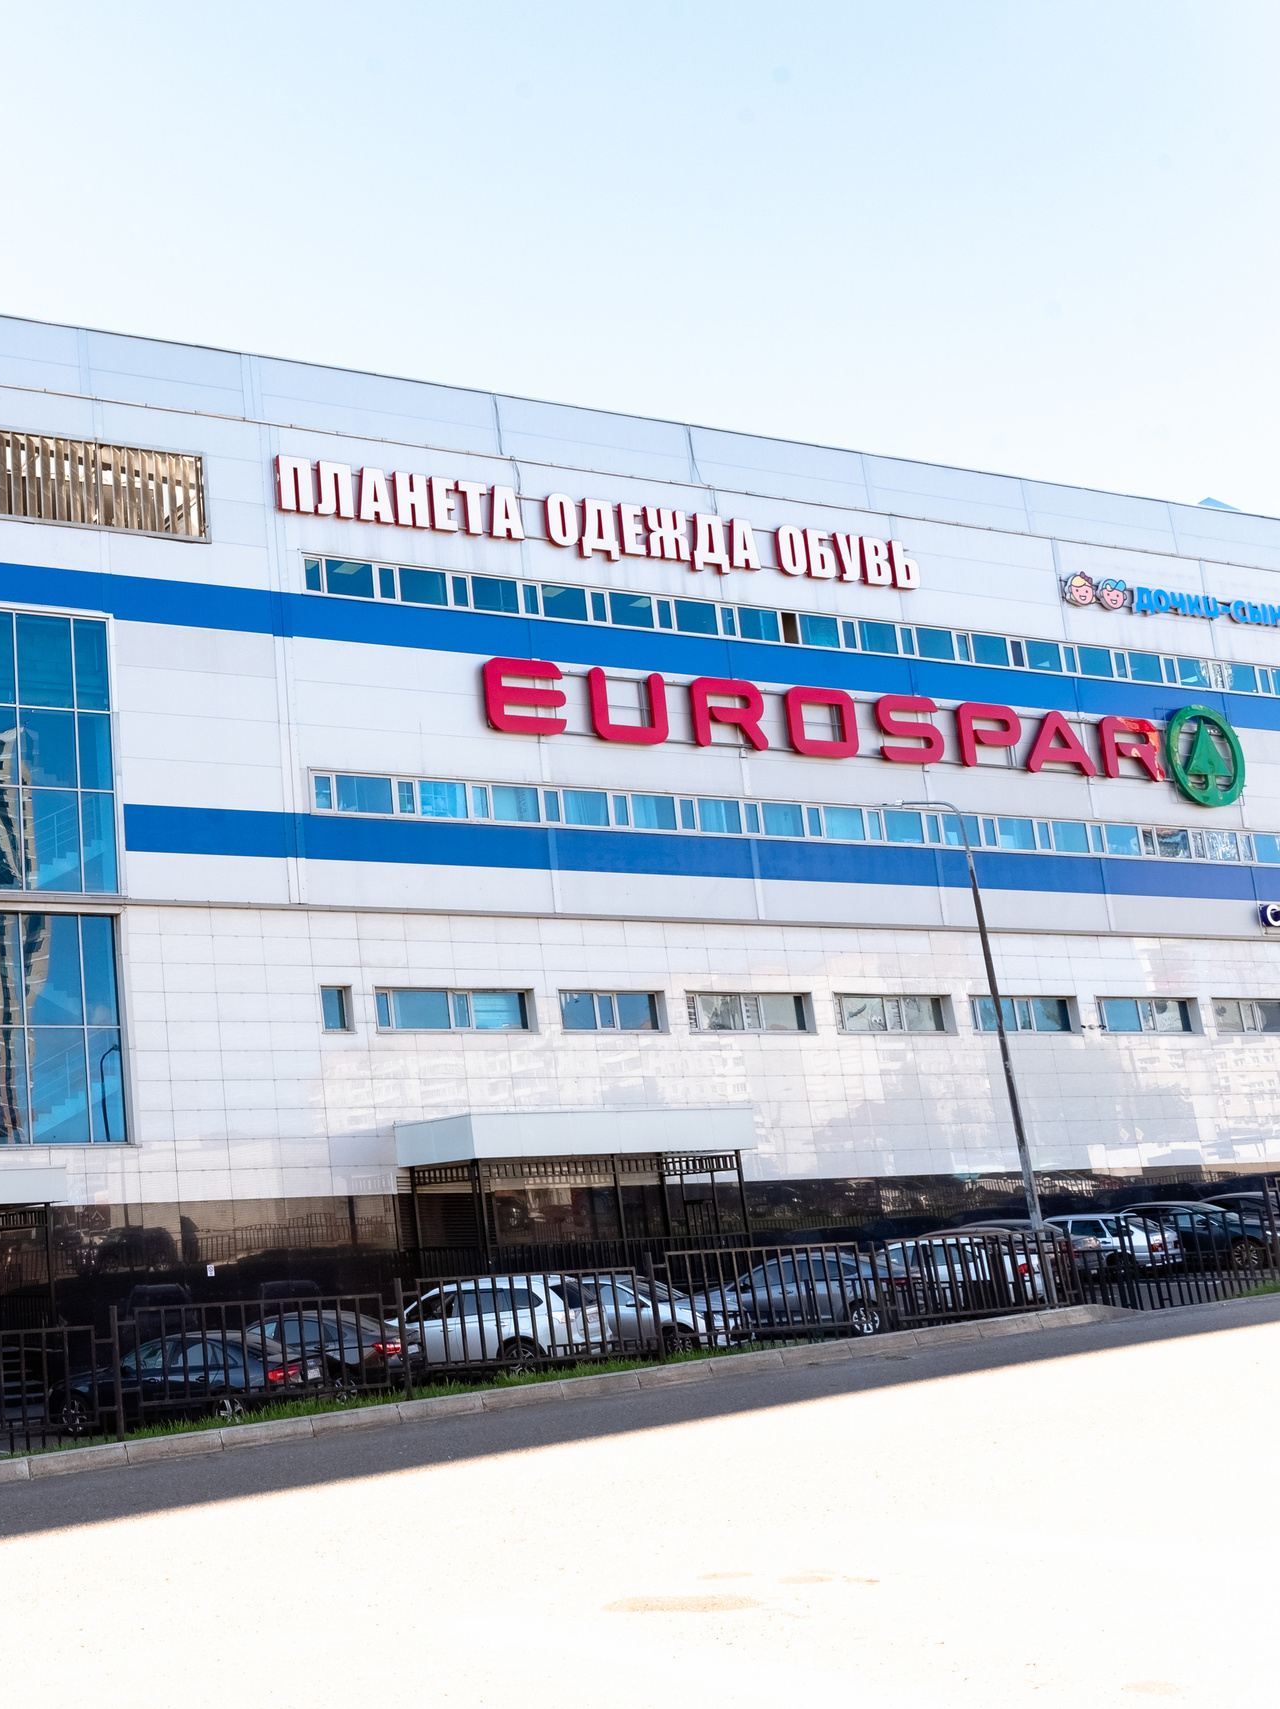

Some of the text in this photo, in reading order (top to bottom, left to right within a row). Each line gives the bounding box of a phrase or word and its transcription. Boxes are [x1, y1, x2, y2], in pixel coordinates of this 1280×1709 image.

[276, 454, 921, 590] ПЛАНЕТА ОДЕЖДА ОБУВЬ
[483, 656, 1166, 783] EUROSPAR
